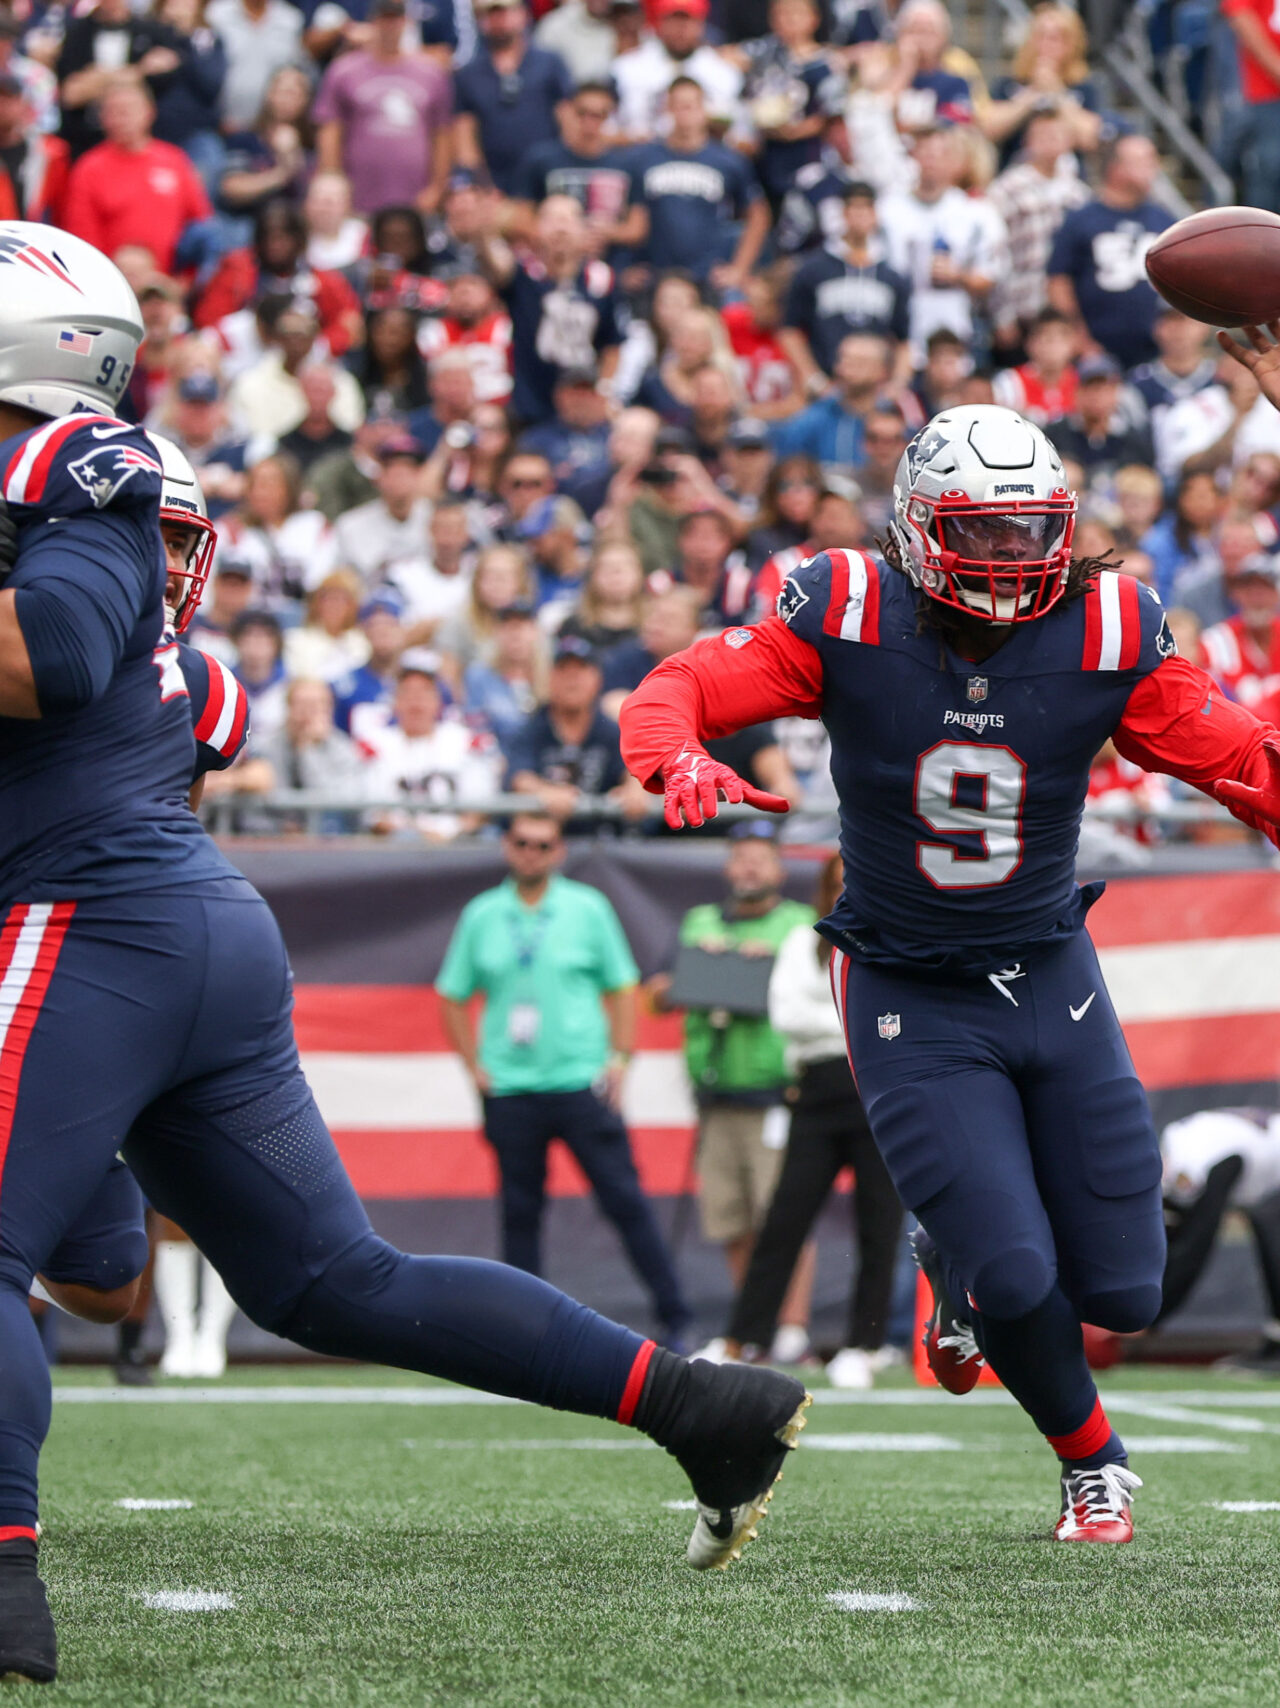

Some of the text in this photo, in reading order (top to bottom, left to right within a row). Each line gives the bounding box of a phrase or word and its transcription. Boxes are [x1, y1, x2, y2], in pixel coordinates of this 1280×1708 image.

[994, 484, 1035, 497] PATRIOTS
[970, 687, 985, 699] NFL
[943, 710, 1005, 729] PATRIOTS
[912, 738, 1028, 890] 9
[881, 1023, 897, 1035] NFL
